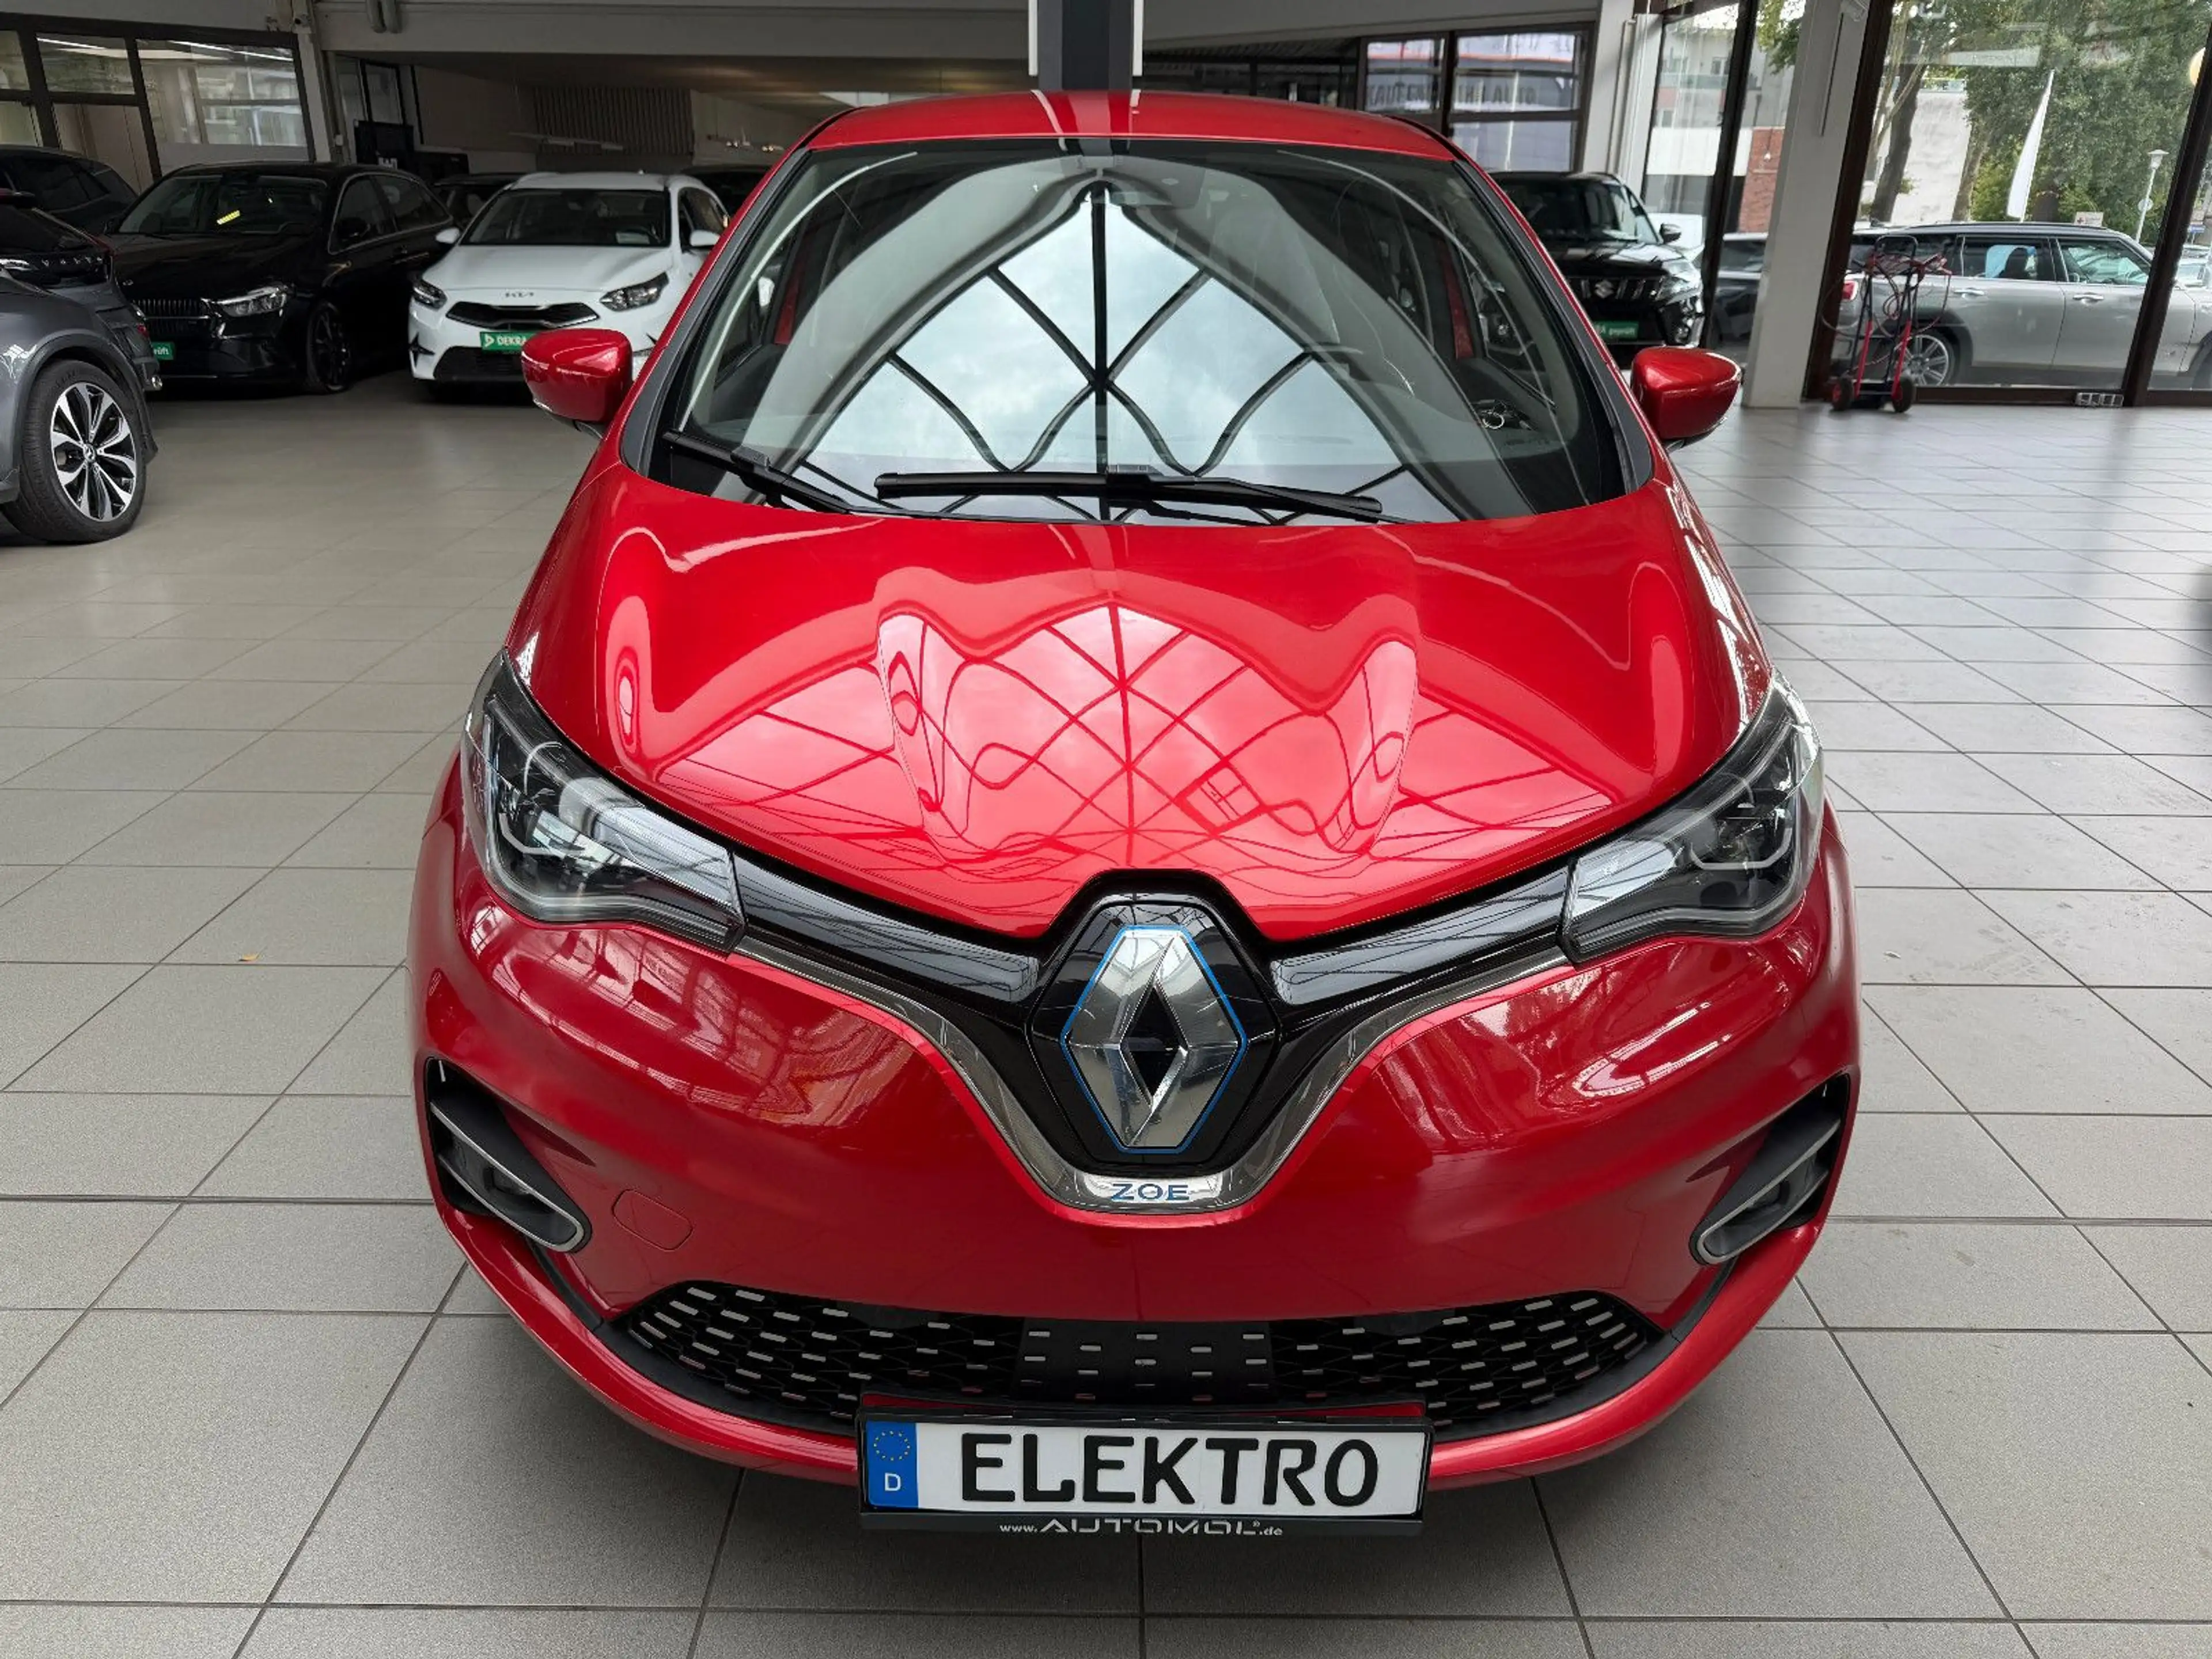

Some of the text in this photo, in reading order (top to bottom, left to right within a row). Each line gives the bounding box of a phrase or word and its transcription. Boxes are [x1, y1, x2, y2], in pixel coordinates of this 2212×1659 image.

[1111, 1183, 1191, 1201] ZOE
[961, 1432, 1378, 1508] ELEKTRO
[884, 1472, 901, 1491] D
